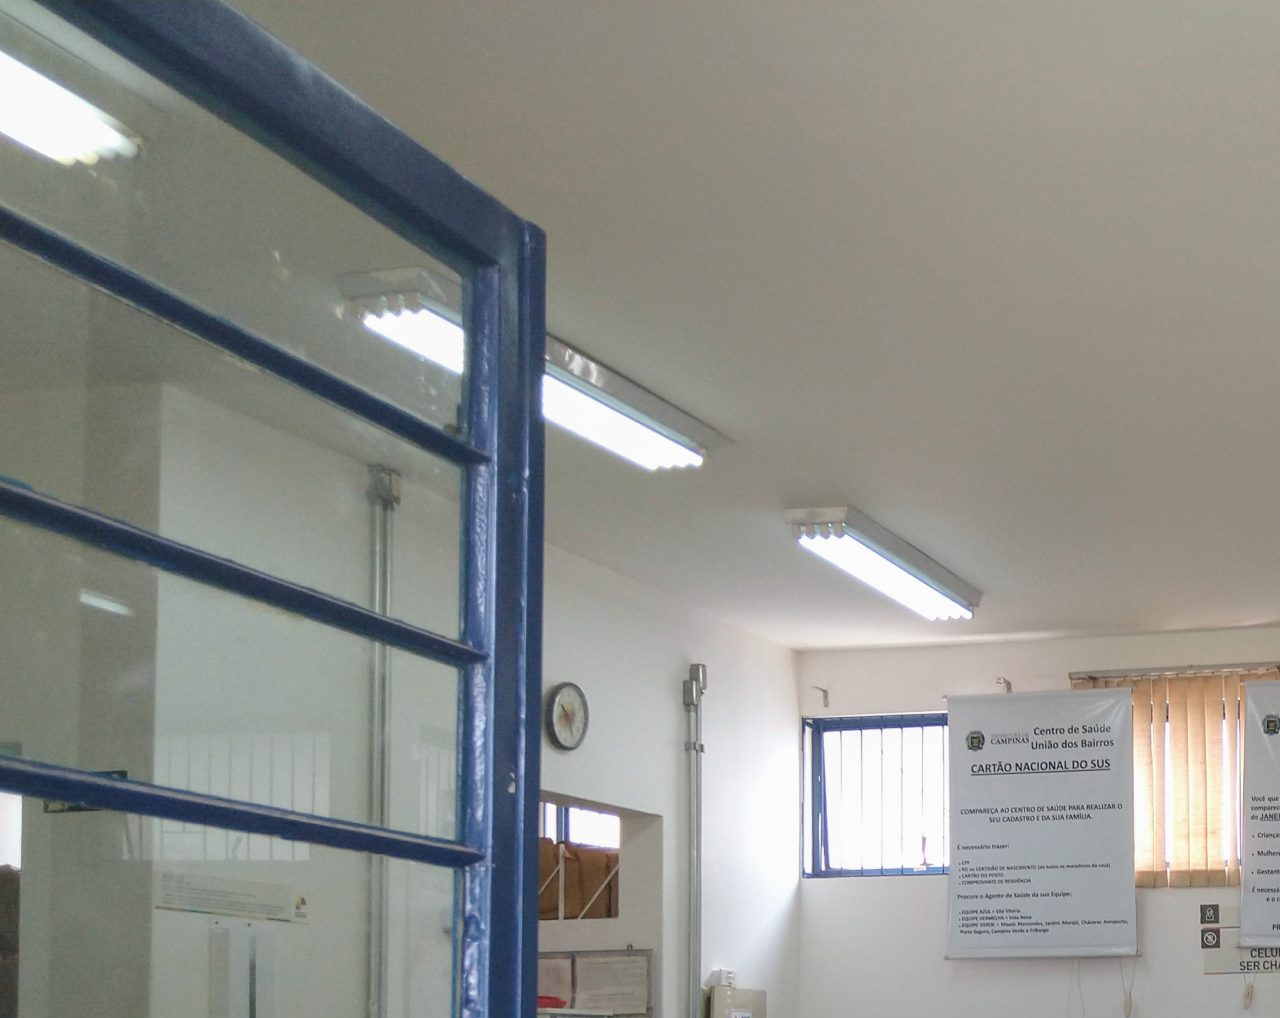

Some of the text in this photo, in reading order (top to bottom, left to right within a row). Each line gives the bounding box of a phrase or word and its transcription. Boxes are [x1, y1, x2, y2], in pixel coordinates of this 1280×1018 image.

[1034, 726, 1065, 735] Centro
[1068, 725, 1079, 734] de
[1082, 724, 1111, 733] Saúde
[991, 737, 1029, 745] CAMPINAS
[1031, 738, 1114, 750] União dos Bairros
[971, 759, 1110, 773] CARTÃO NACIONAL DO SUS
[1047, 804, 1066, 812] SAÚDE
[1257, 831, 1280, 840] Crianças
[1240, 961, 1260, 971] SER
